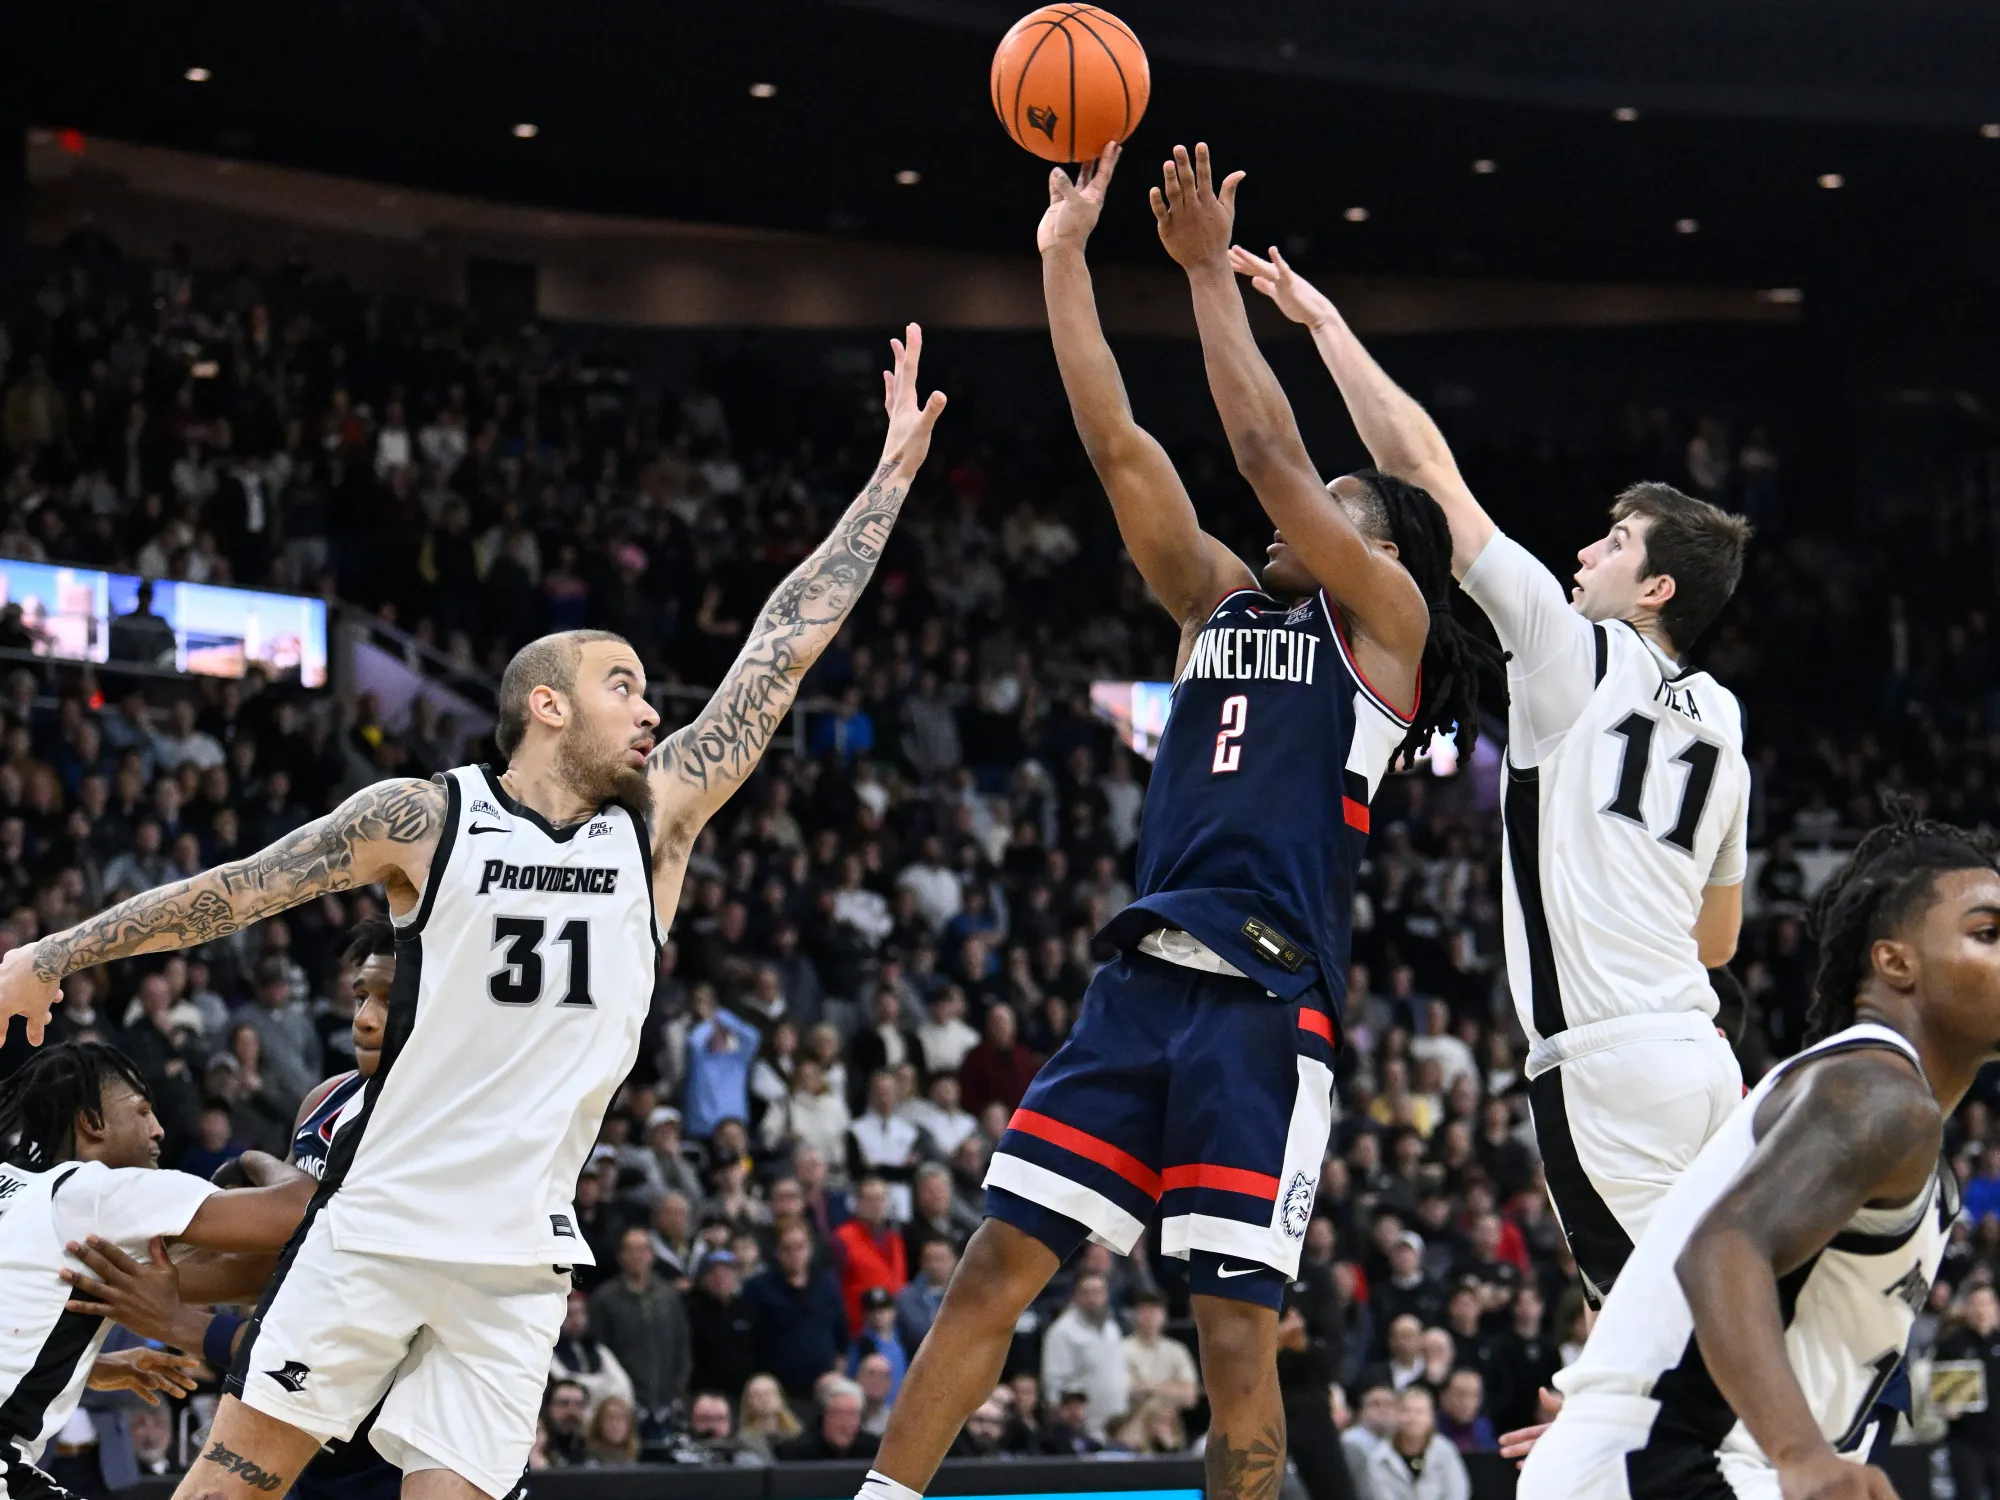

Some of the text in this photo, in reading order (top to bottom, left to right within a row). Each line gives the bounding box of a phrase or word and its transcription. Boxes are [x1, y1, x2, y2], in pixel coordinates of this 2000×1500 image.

[1211, 694, 1248, 774] 2
[1598, 708, 1724, 860] 11
[588, 827, 614, 837] EAST
[590, 821, 607, 829] BIG
[475, 859, 620, 896] PROVIDENCE
[486, 913, 597, 1009] 31
[1284, 950, 1296, 961] 46
[203, 1441, 281, 1491] BEYOND
